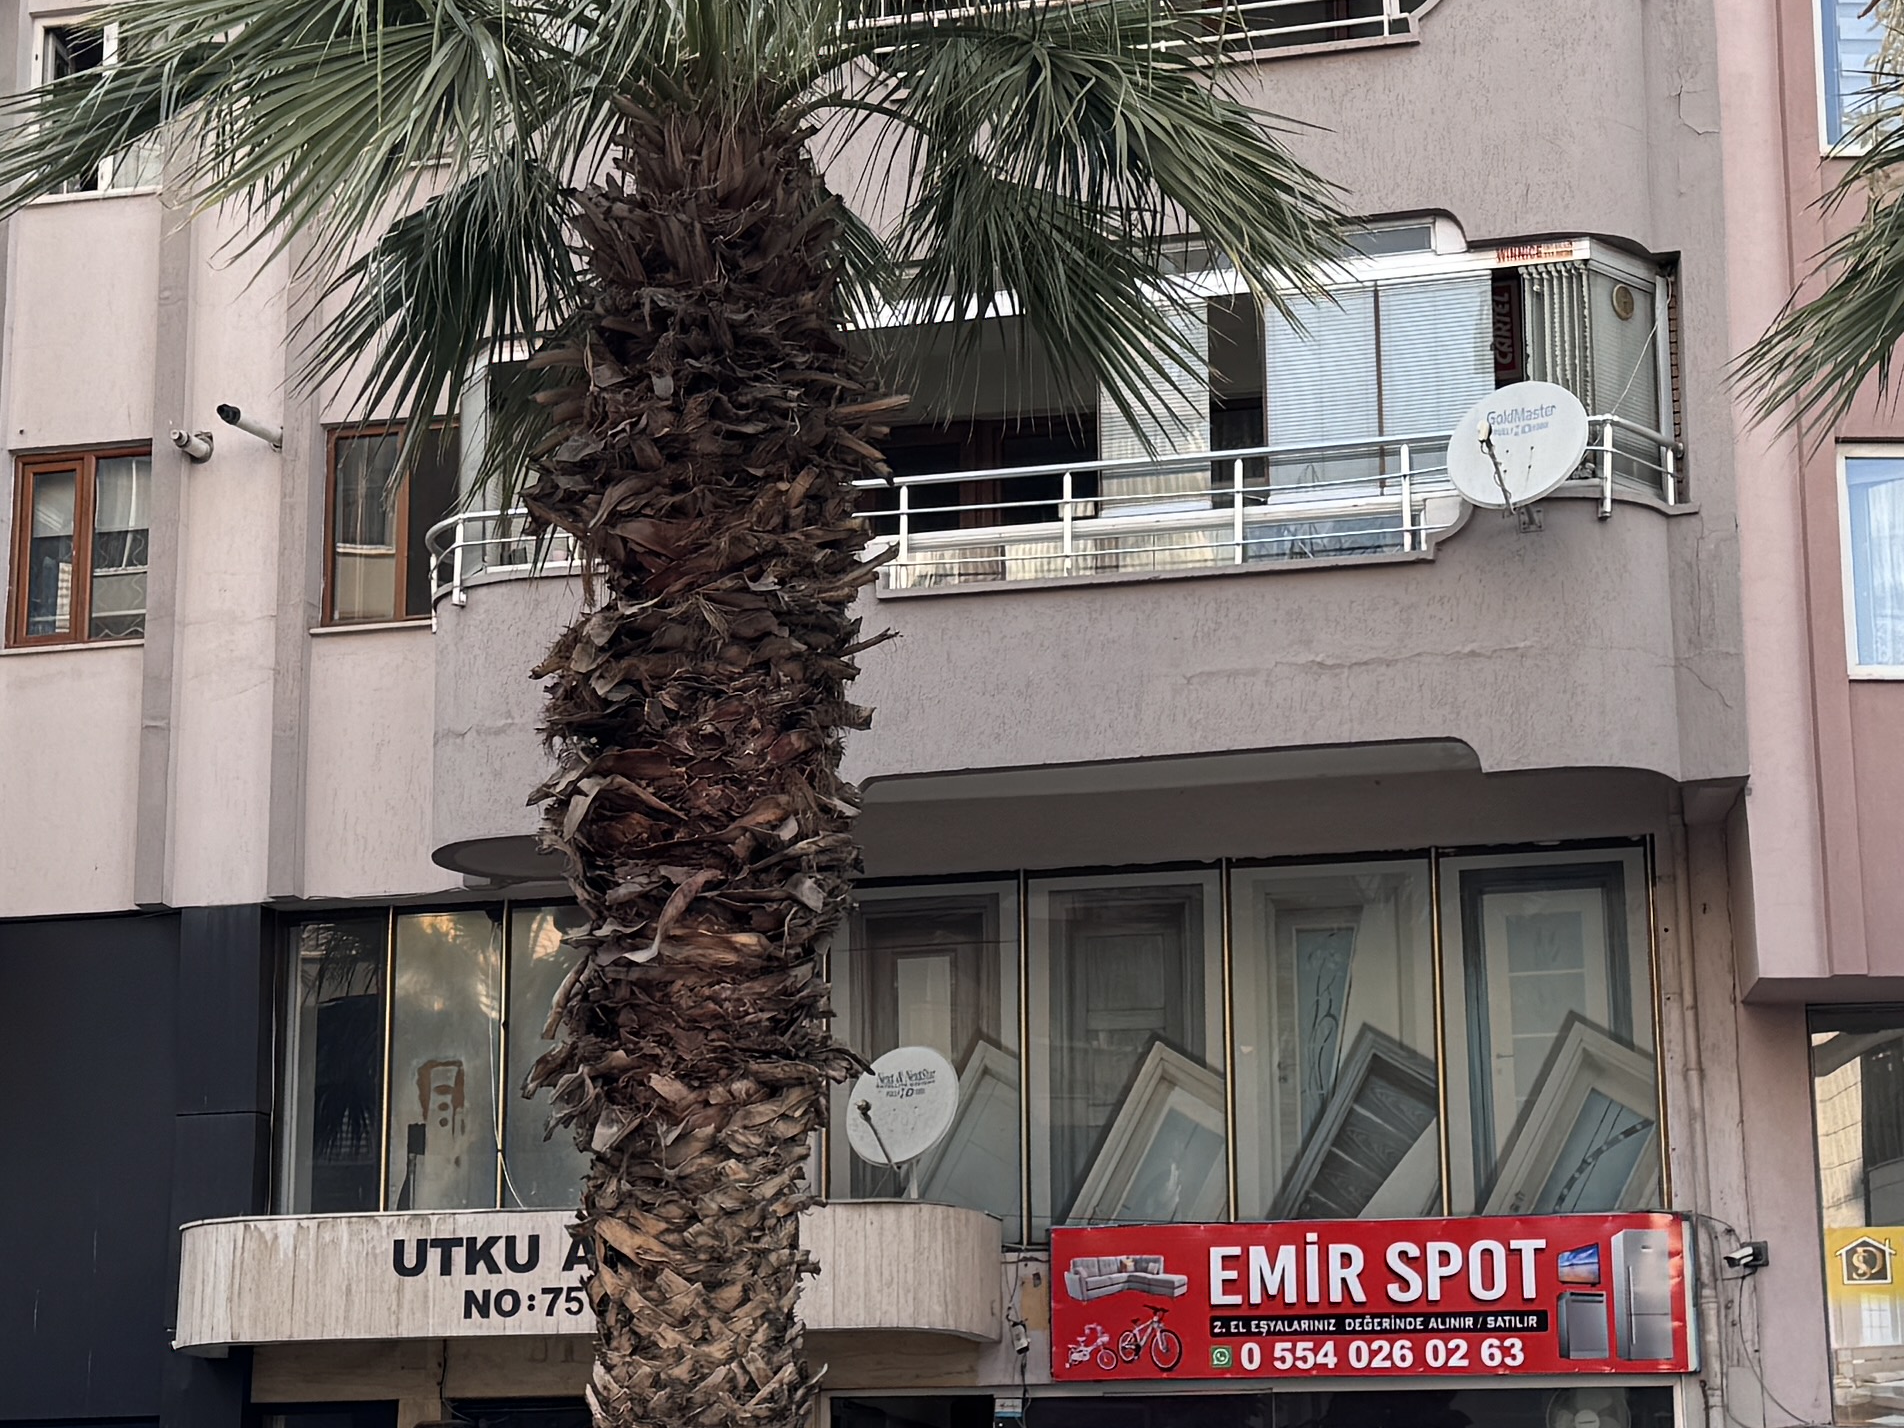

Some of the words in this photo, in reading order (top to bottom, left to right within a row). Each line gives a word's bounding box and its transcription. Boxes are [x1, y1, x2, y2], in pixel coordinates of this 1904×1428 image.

[1487, 404, 1556, 425] GoldMaster
[393, 1234, 540, 1278] UTKU
[1210, 1232, 1367, 1305] EMİR
[1386, 1238, 1547, 1303] SPOT
[1213, 1321, 1226, 1333] 2.
[1230, 1320, 1246, 1332] EL
[1251, 1318, 1336, 1337] EŞYALARINIZ
[1345, 1314, 1424, 1331] DEĞERİNDE
[1429, 1317, 1474, 1329] ALINIR
[1487, 1315, 1538, 1329] SATILIR
[1240, 1342, 1261, 1371] 0
[1273, 1340, 1338, 1370] 554
[1348, 1339, 1414, 1369] 026
[1425, 1338, 1469, 1368] 02
[1480, 1337, 1525, 1367] 63
